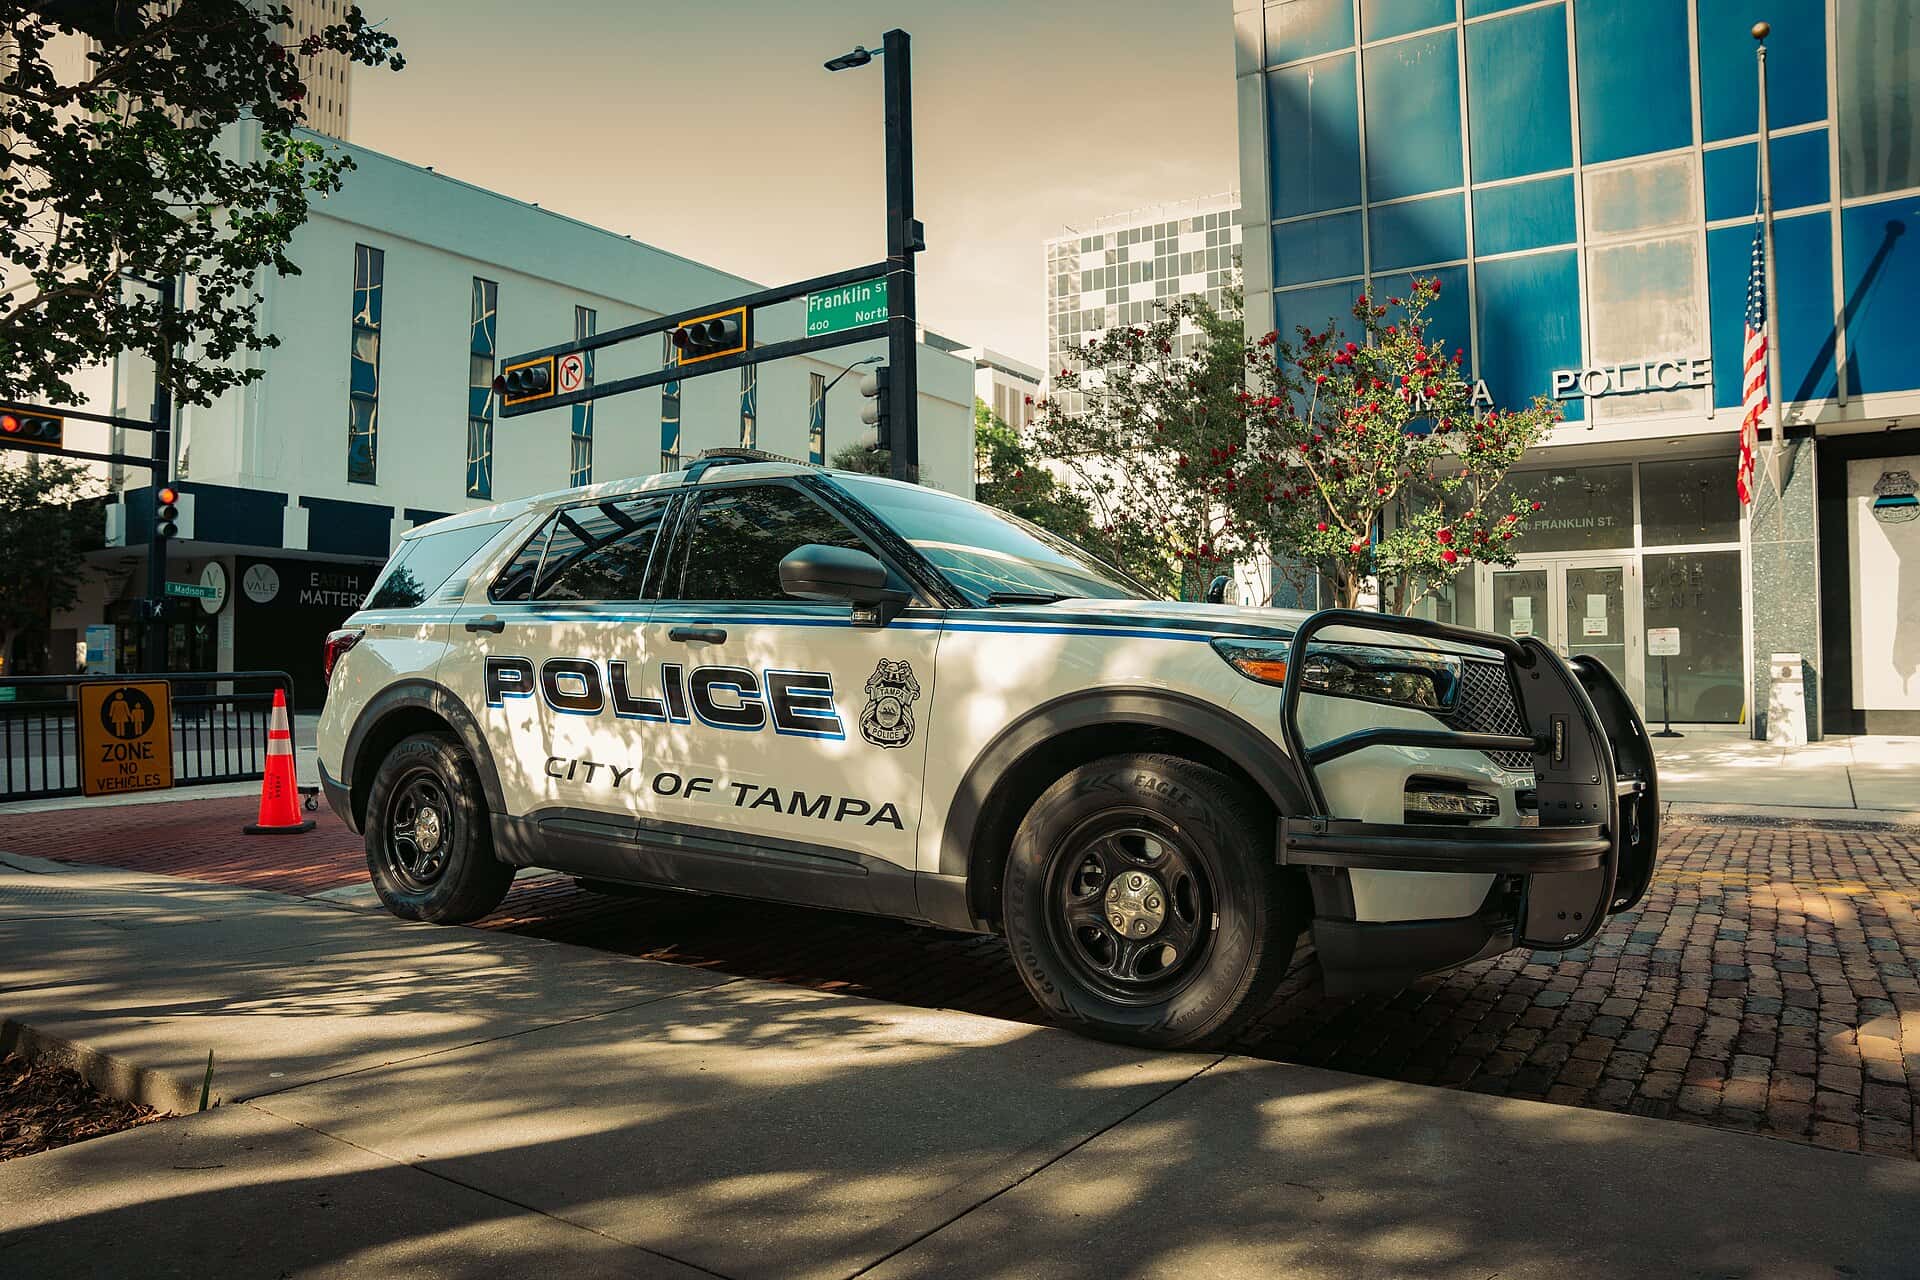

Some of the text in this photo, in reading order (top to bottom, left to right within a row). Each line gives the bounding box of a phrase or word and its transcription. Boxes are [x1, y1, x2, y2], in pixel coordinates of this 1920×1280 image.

[809, 282, 888, 312] Franklin ST
[809, 307, 888, 331] 400 North
[1552, 359, 1712, 399] POLICE
[1534, 517, 1594, 530] FRANKLIN
[1597, 516, 1615, 527] ST.
[173, 583, 205, 596] Madison
[246, 581, 277, 593] VALE
[311, 572, 359, 591] EARH
[300, 590, 367, 607] MATTERS
[484, 656, 846, 741] POLICE
[879, 687, 905, 699] TAMPA
[872, 728, 899, 739] POLICE
[102, 742, 154, 762] ZONE
[119, 762, 138, 775] NO
[96, 774, 161, 791] VEHICLES
[544, 756, 905, 830] CITY OF TAMPA
